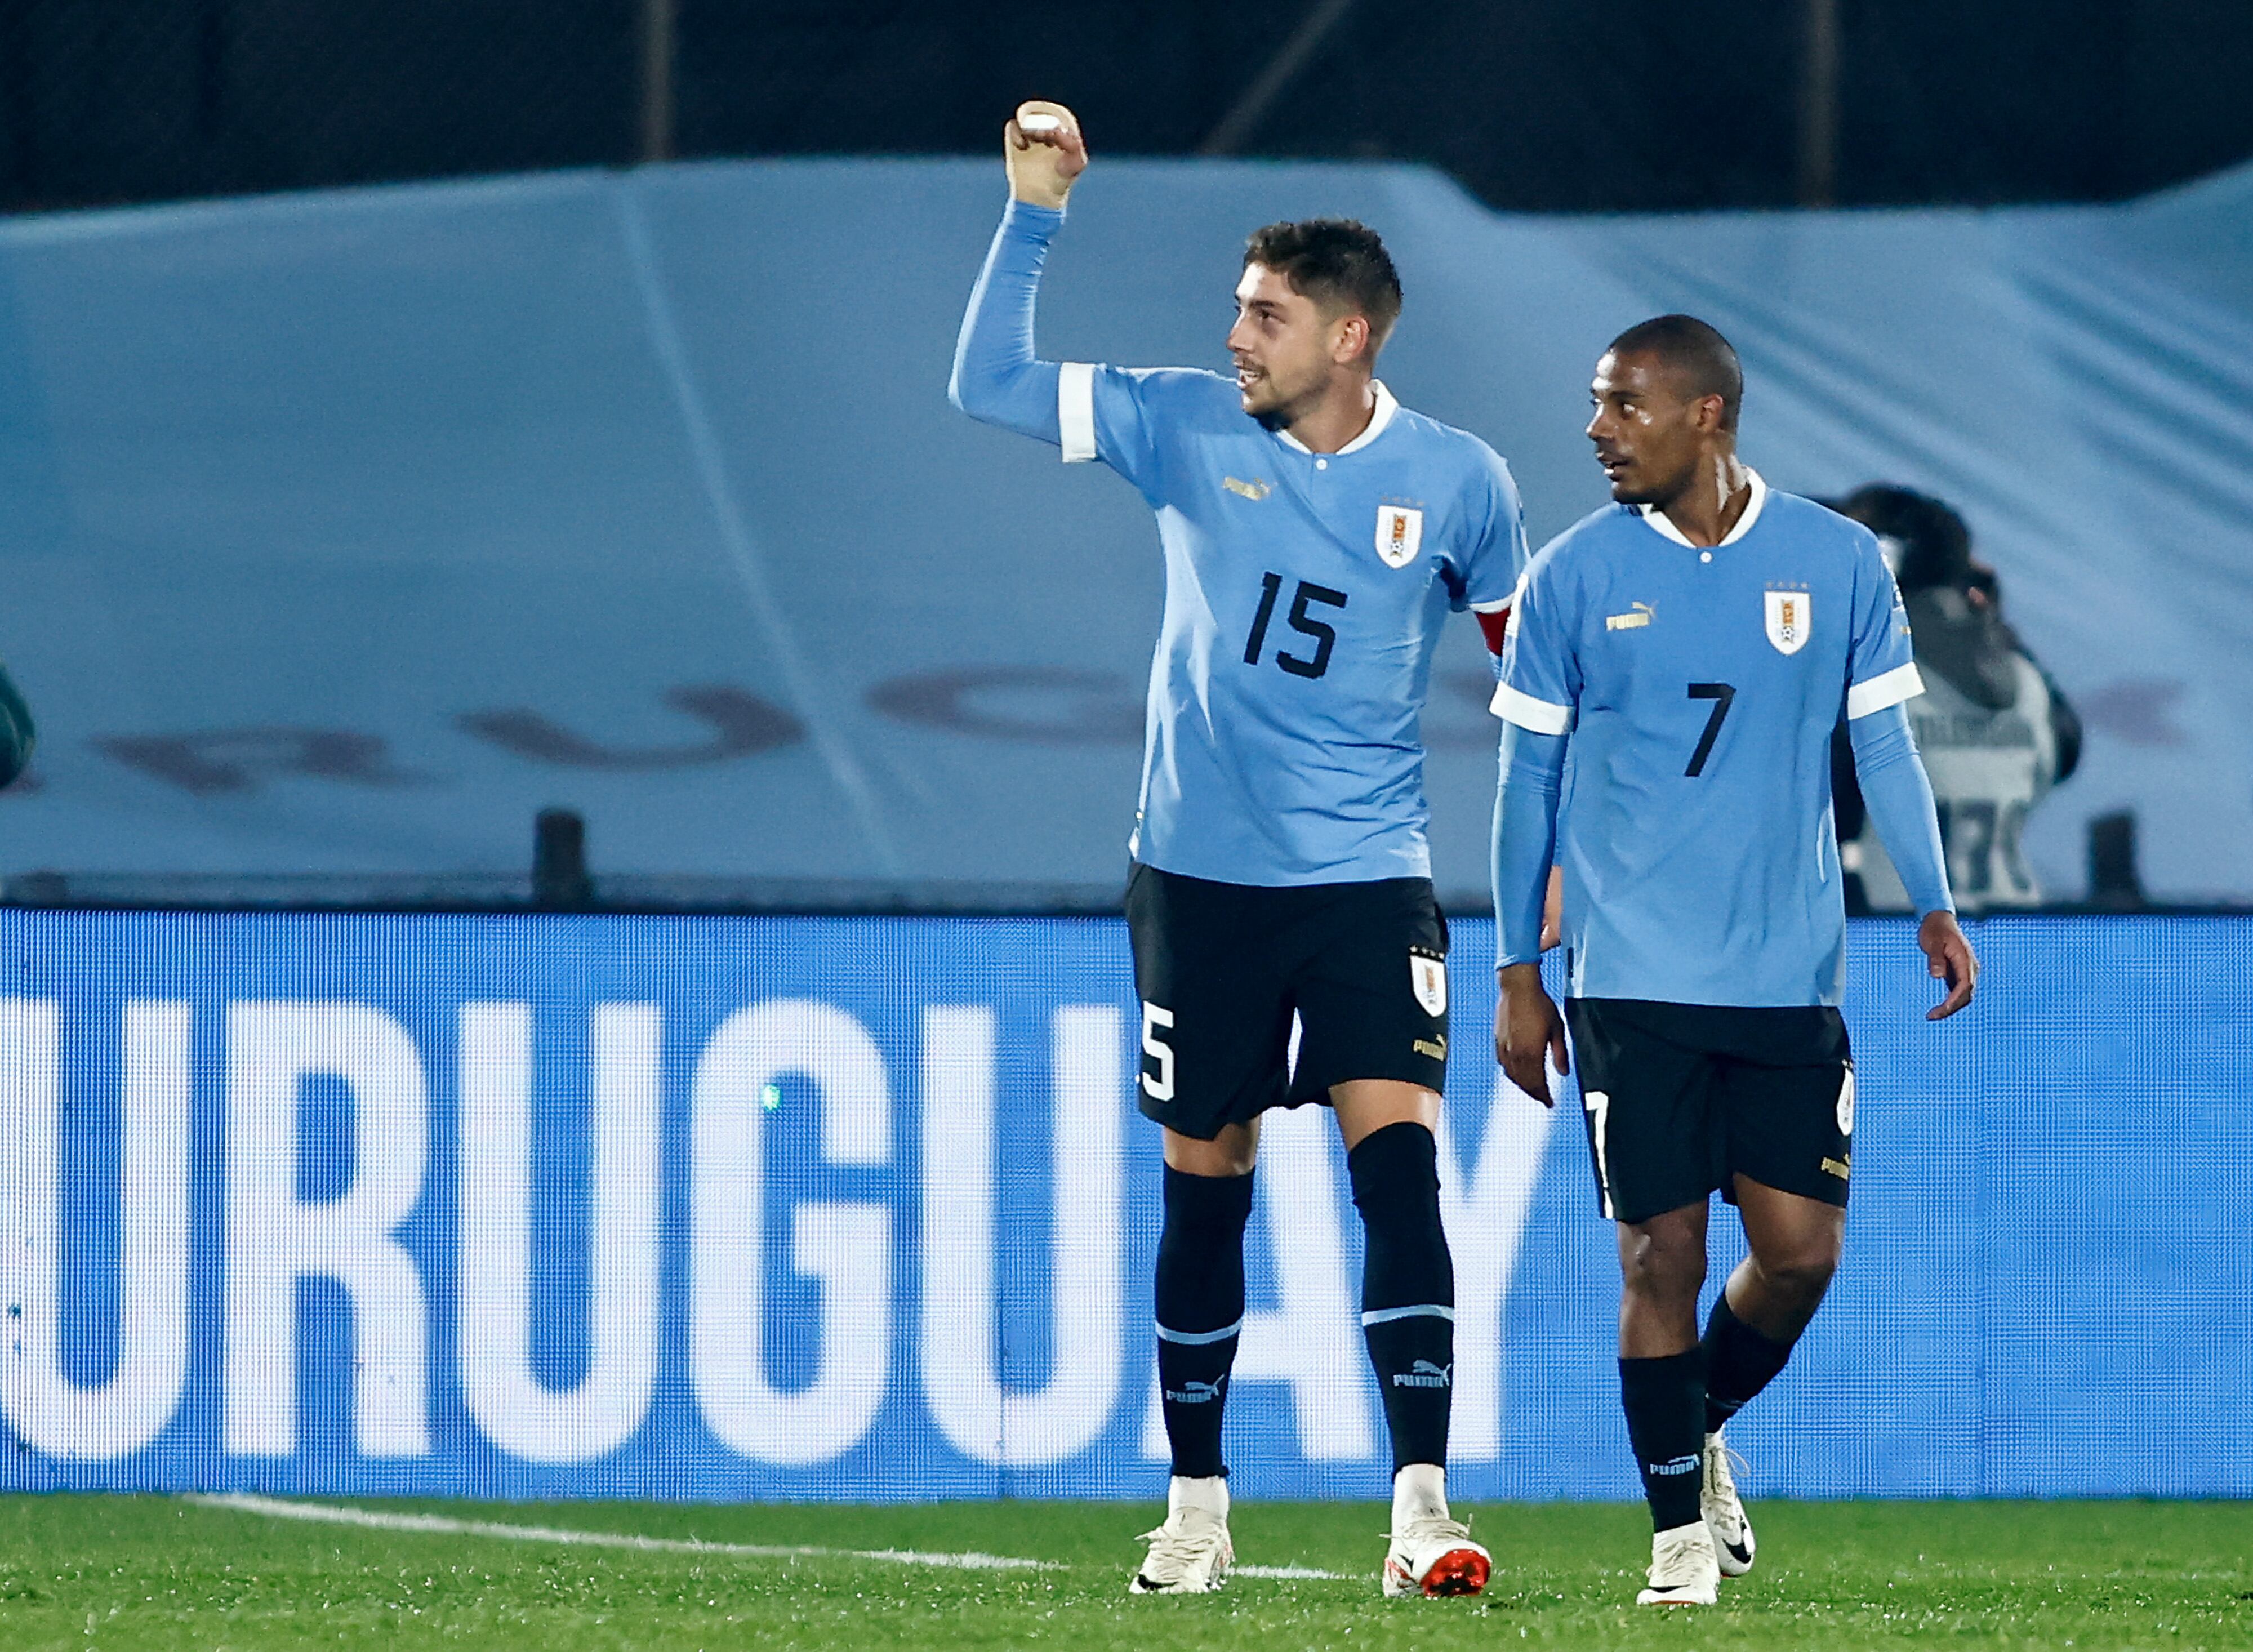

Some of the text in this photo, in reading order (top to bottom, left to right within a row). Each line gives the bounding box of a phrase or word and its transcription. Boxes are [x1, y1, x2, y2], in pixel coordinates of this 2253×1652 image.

[1243, 571, 1348, 679] 15
[1684, 683, 1736, 777] 7
[1584, 1090, 1614, 1219] 7
